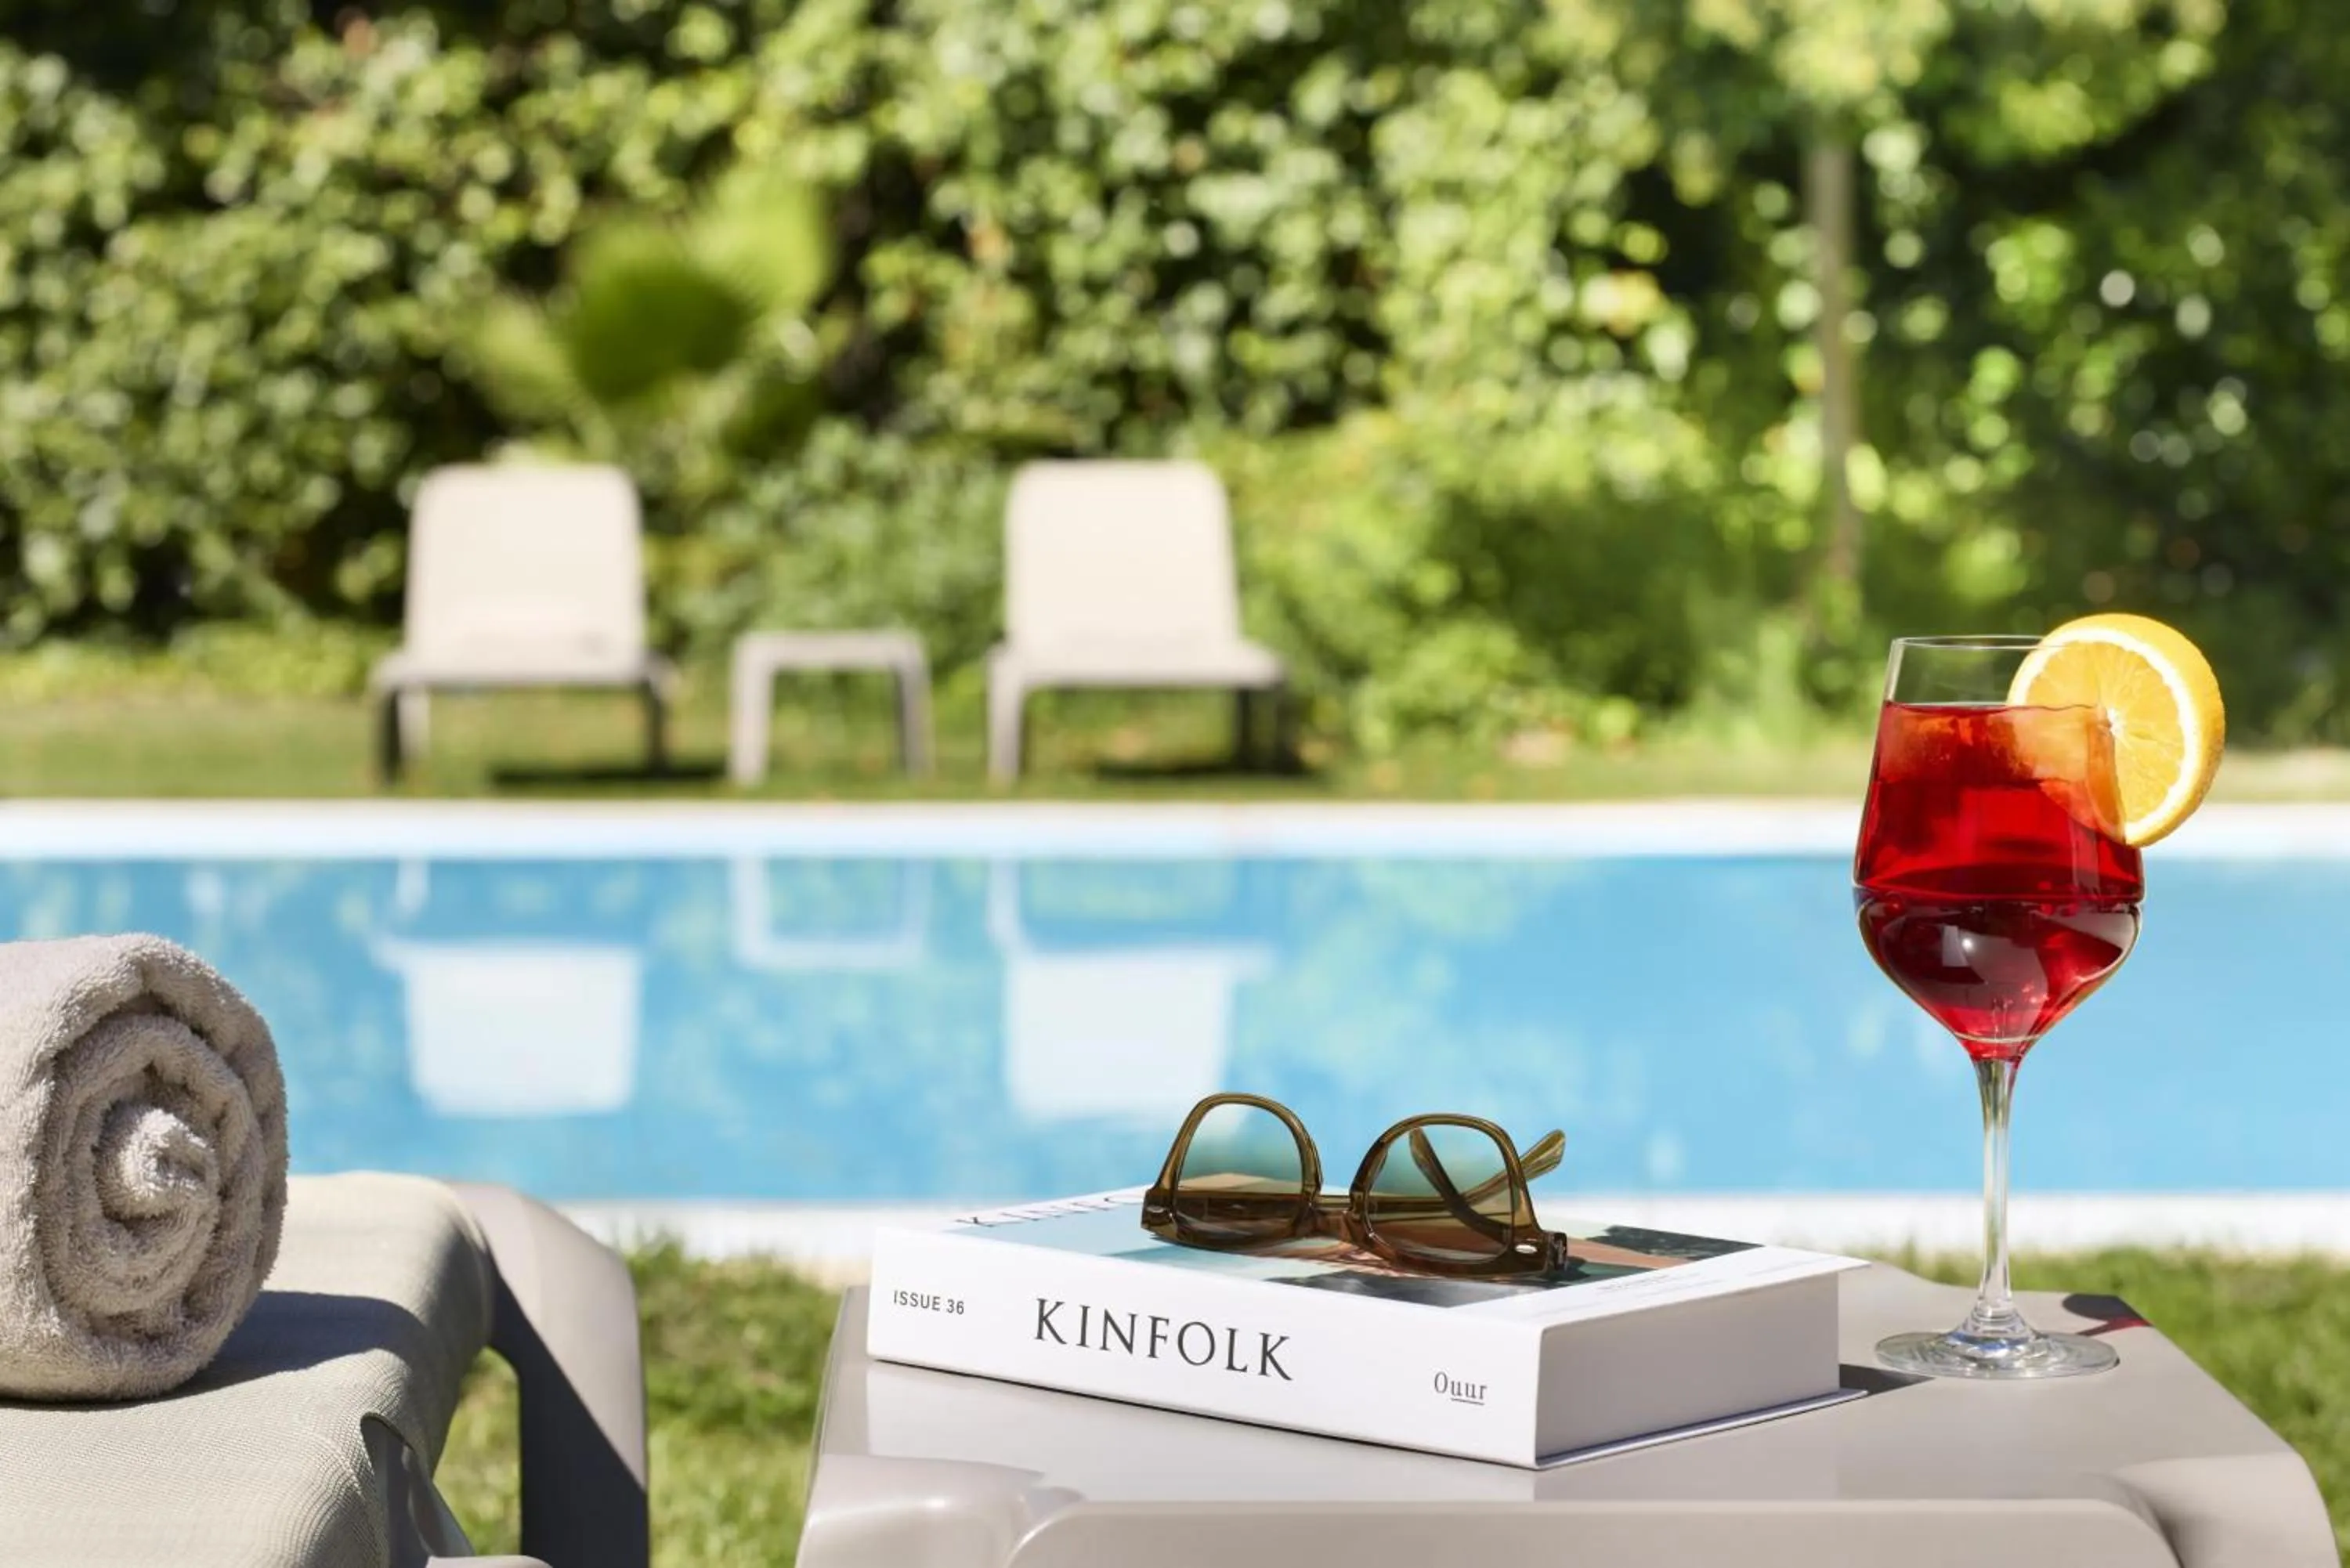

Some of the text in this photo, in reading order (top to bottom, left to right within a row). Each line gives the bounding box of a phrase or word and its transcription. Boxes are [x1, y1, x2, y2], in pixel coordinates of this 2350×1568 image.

[892, 1289, 965, 1315] ISSUE 36
[1035, 1298, 1292, 1381] KINFOLK
[1434, 1371, 1488, 1400] Ouur
